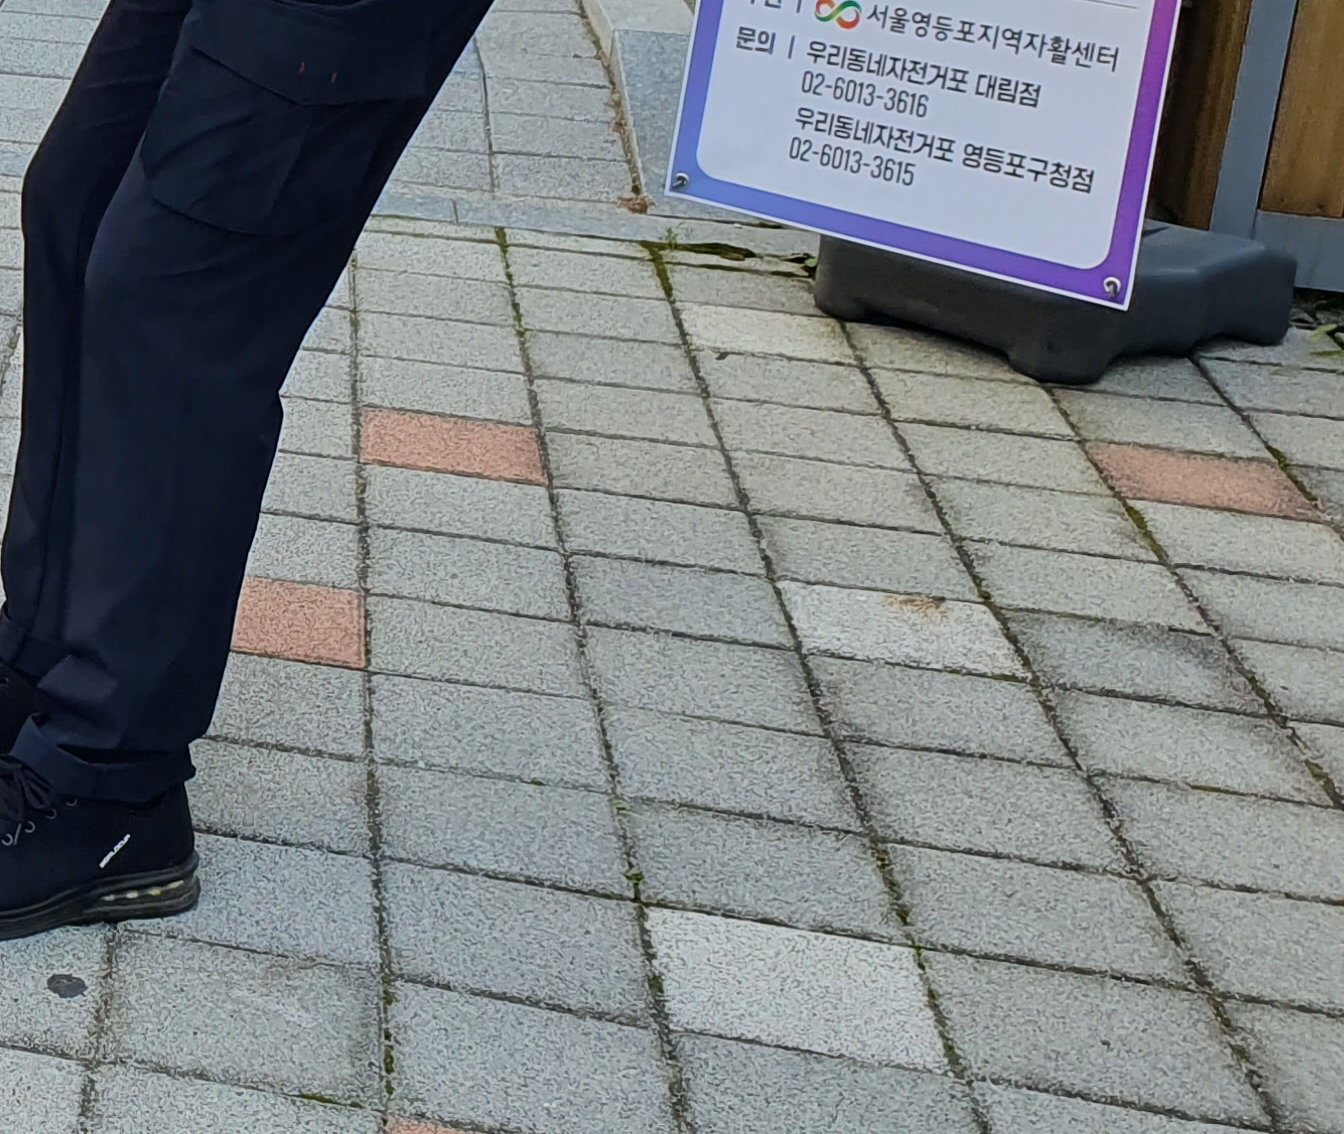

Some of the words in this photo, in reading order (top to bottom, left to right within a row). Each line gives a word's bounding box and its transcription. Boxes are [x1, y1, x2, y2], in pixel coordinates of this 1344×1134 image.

[736, 27, 776, 55] 문의
[806, 40, 969, 93] 우리동네자전거포
[975, 72, 1041, 109] 대림점
[867, 6, 1120, 72] 서울영등포지역자활센터
[800, 70, 928, 119] 02-6013-3616
[789, 136, 915, 188] 02-6013-3615
[795, 107, 956, 164] 우리동네자전거포
[962, 142, 1094, 194] 영등포구청점
